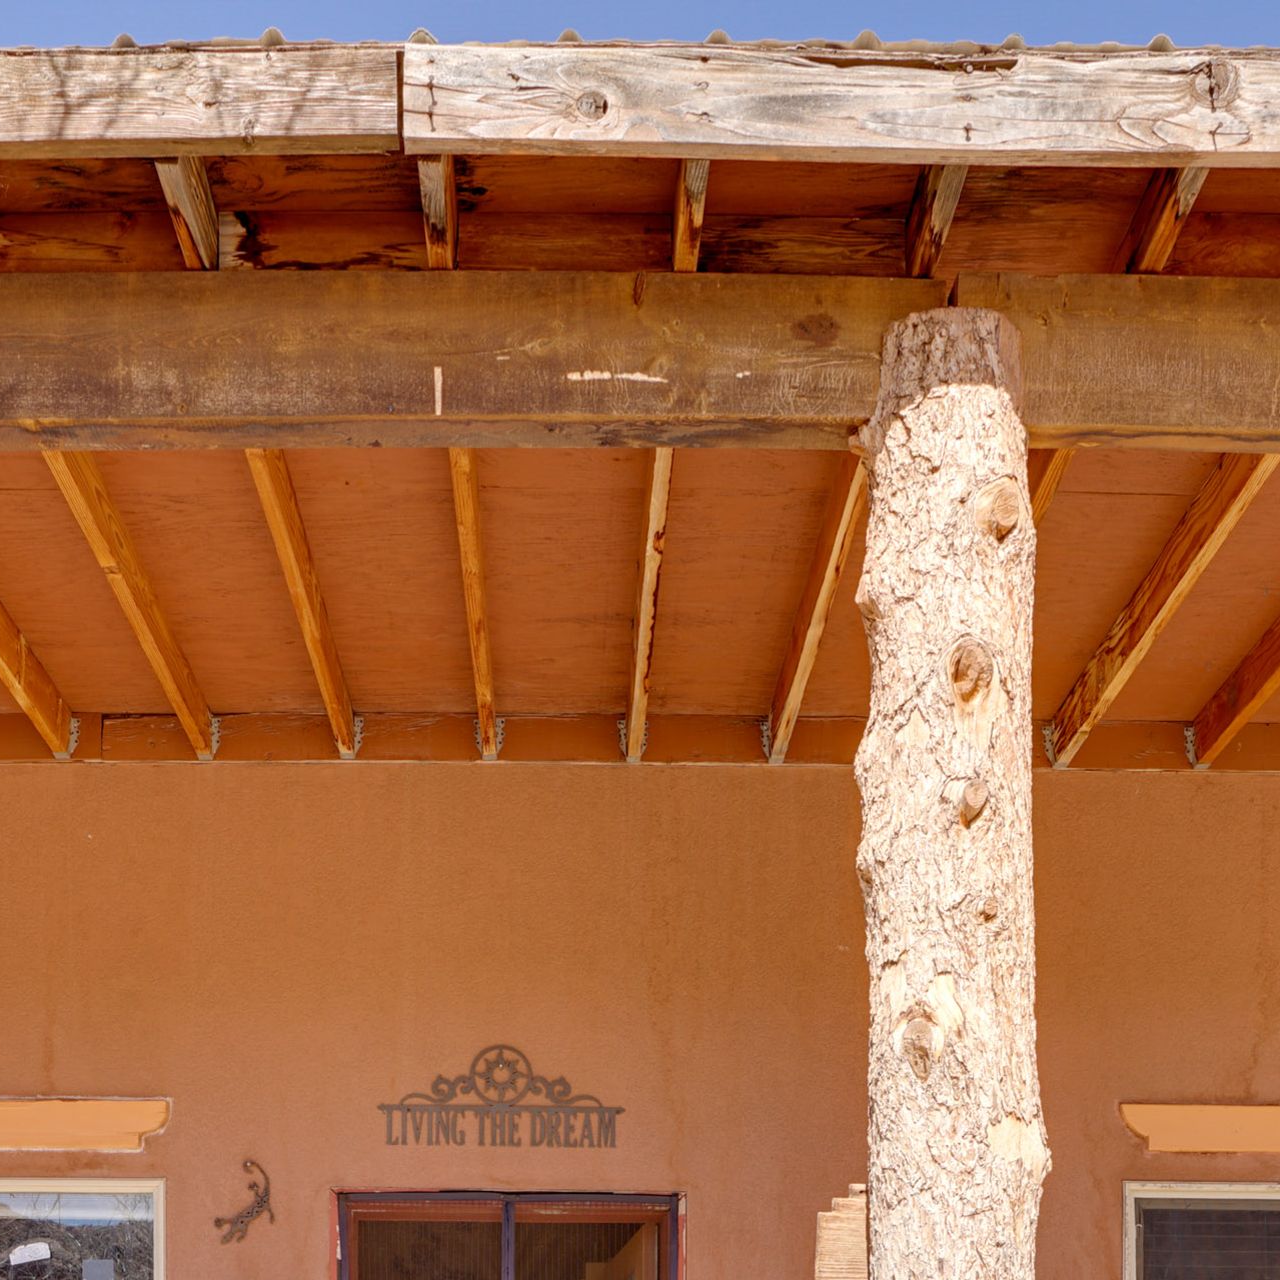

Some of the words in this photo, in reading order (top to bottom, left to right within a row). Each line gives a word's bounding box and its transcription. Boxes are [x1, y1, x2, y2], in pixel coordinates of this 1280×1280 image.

[386, 1106, 466, 1146] LIVING
[476, 1106, 521, 1146] THE
[530, 1107, 616, 1148] DREAM
